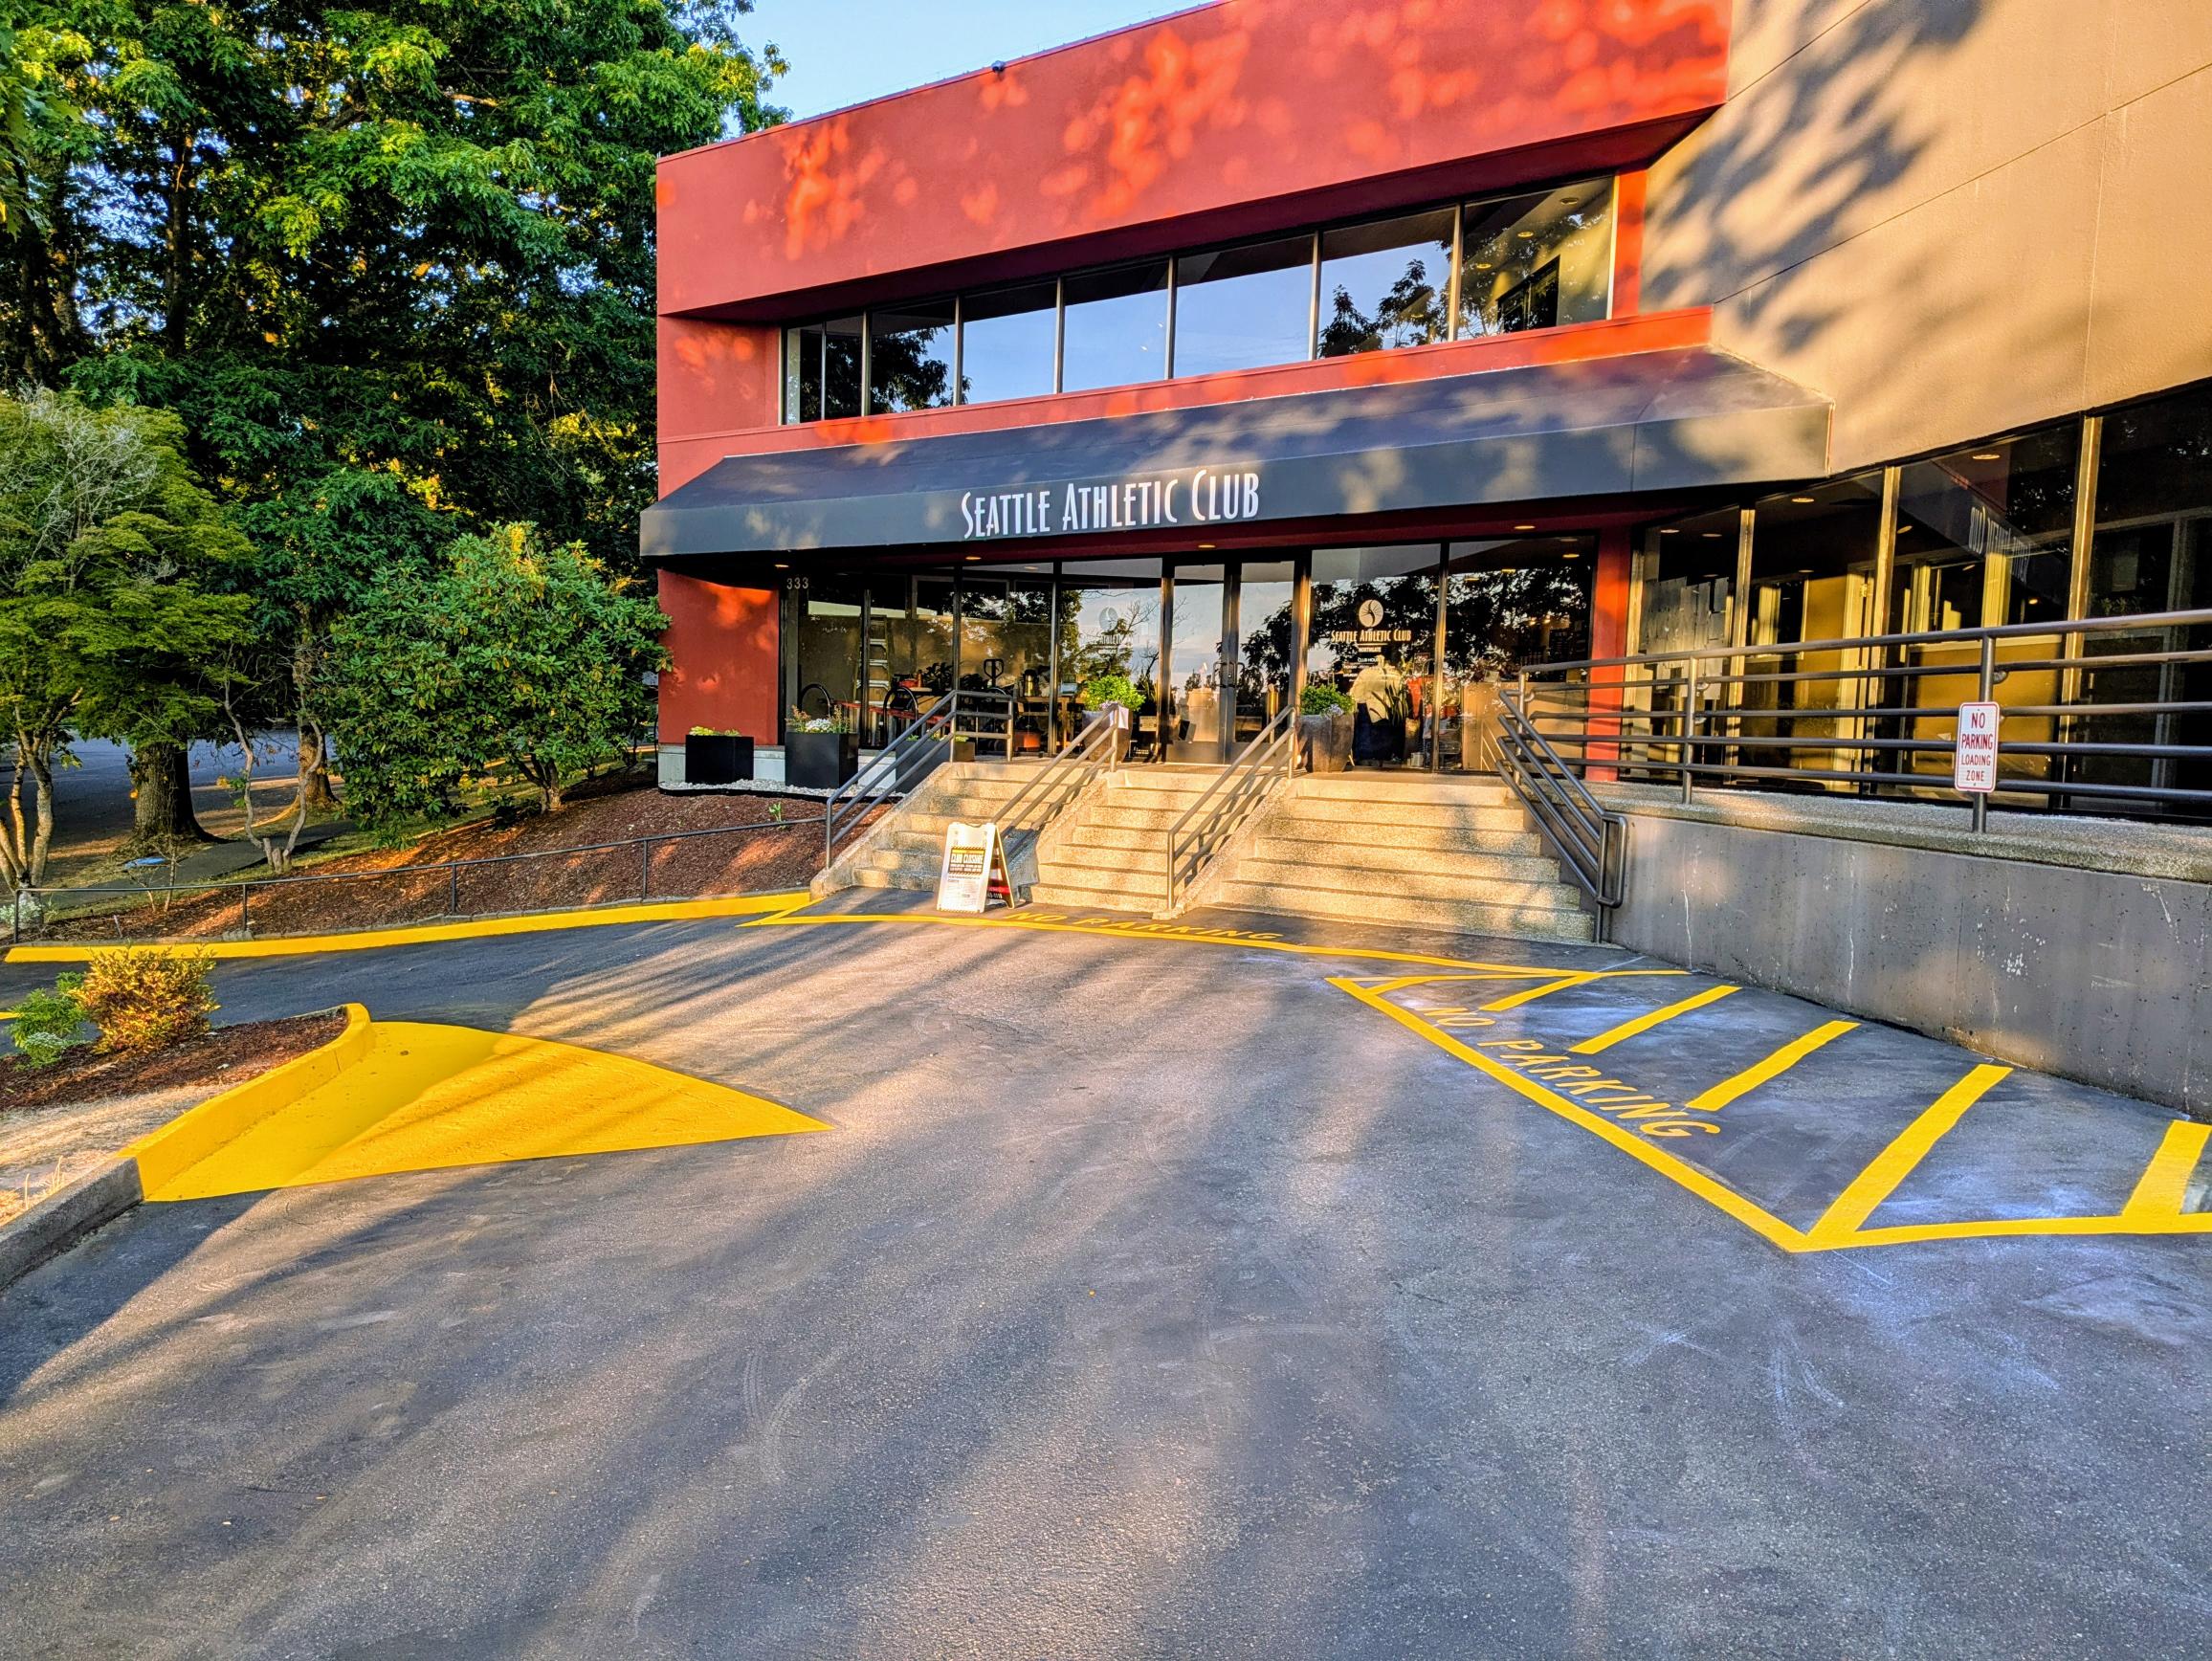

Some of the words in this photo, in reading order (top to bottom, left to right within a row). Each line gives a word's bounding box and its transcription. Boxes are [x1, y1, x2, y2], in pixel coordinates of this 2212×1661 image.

[961, 491, 1051, 539] SEATTLE
[1062, 478, 1179, 530] ATHLETIC
[1191, 469, 1260, 521] CLUB
[786, 576, 808, 589] 333
[1331, 630, 1358, 642] SEATTLE
[1360, 630, 1391, 642] ATHLETIC
[1393, 629, 1412, 642] CLUB
[1971, 712, 1986, 728] NO
[1961, 733, 1993, 749] PARKING
[1961, 754, 1991, 765] LOADING
[1966, 770, 1984, 781] ZONE
[1004, 912, 1068, 921] NO
[1073, 918, 1284, 940] PARKING
[1413, 1007, 1496, 1027] NO
[1476, 1039, 1721, 1138] PARKING
